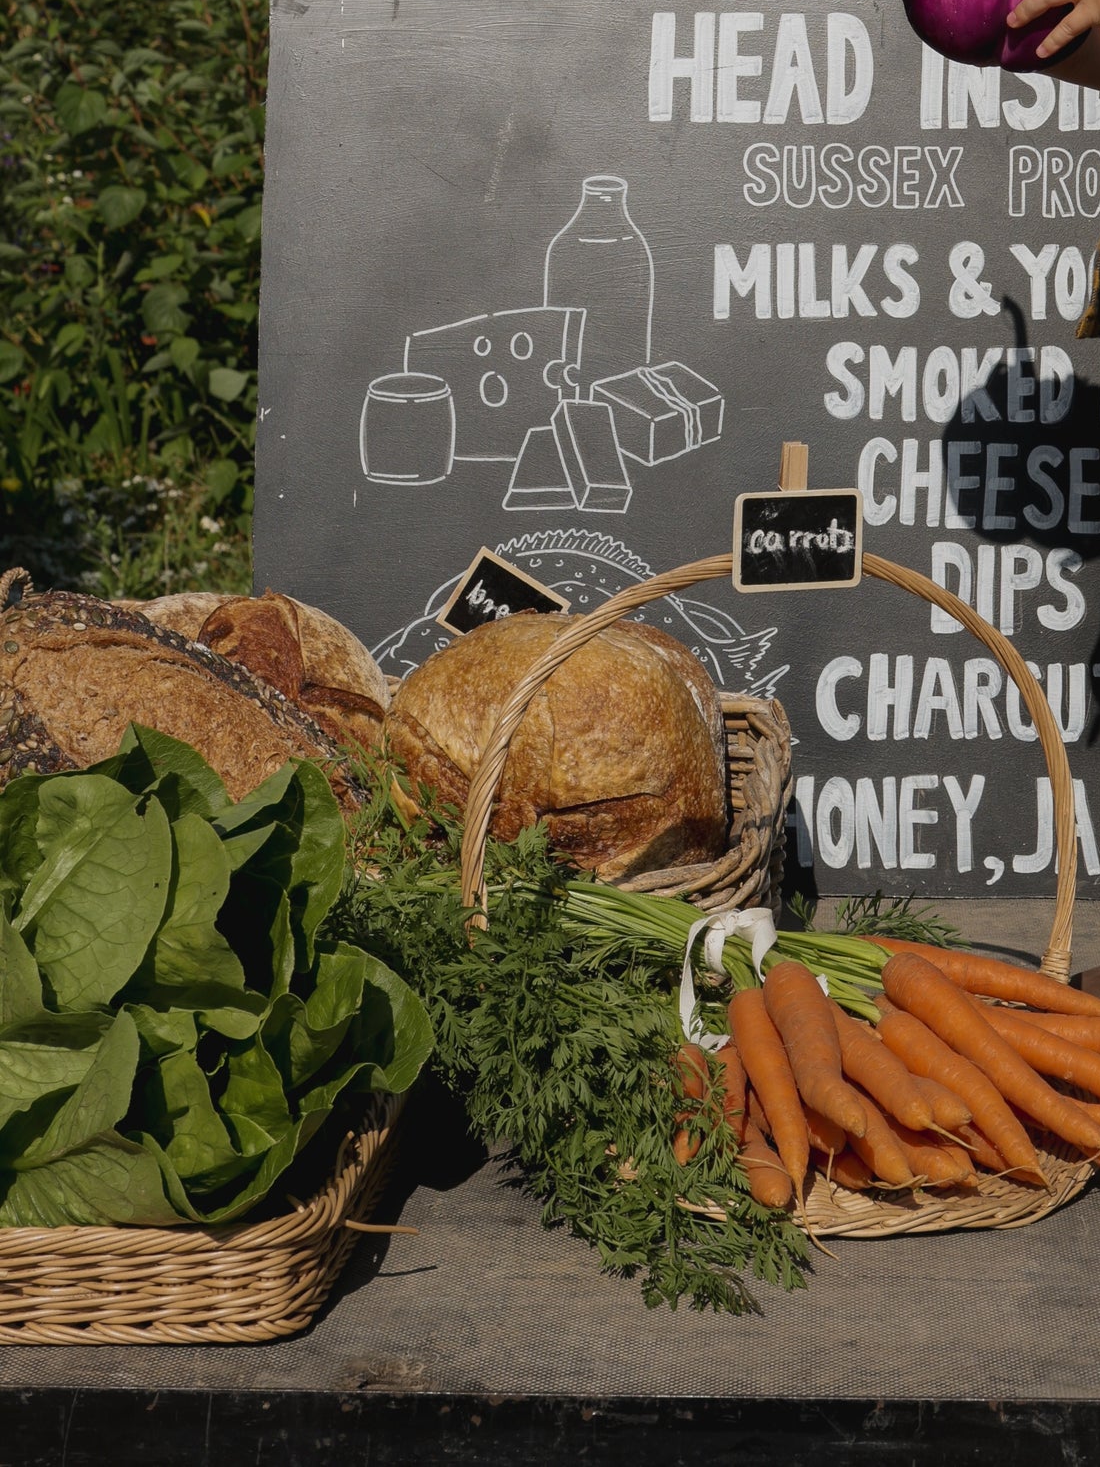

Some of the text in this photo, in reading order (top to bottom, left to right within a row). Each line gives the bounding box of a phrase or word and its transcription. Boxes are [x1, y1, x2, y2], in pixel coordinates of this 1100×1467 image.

[649, 12, 874, 124] HEAD
[743, 142, 965, 209] SUSSEX
[713, 240, 1097, 322] MILKS & YO
[823, 341, 1075, 424] SMOKED
[750, 517, 855, 554] carrots
[931, 541, 1087, 636] DIPS
